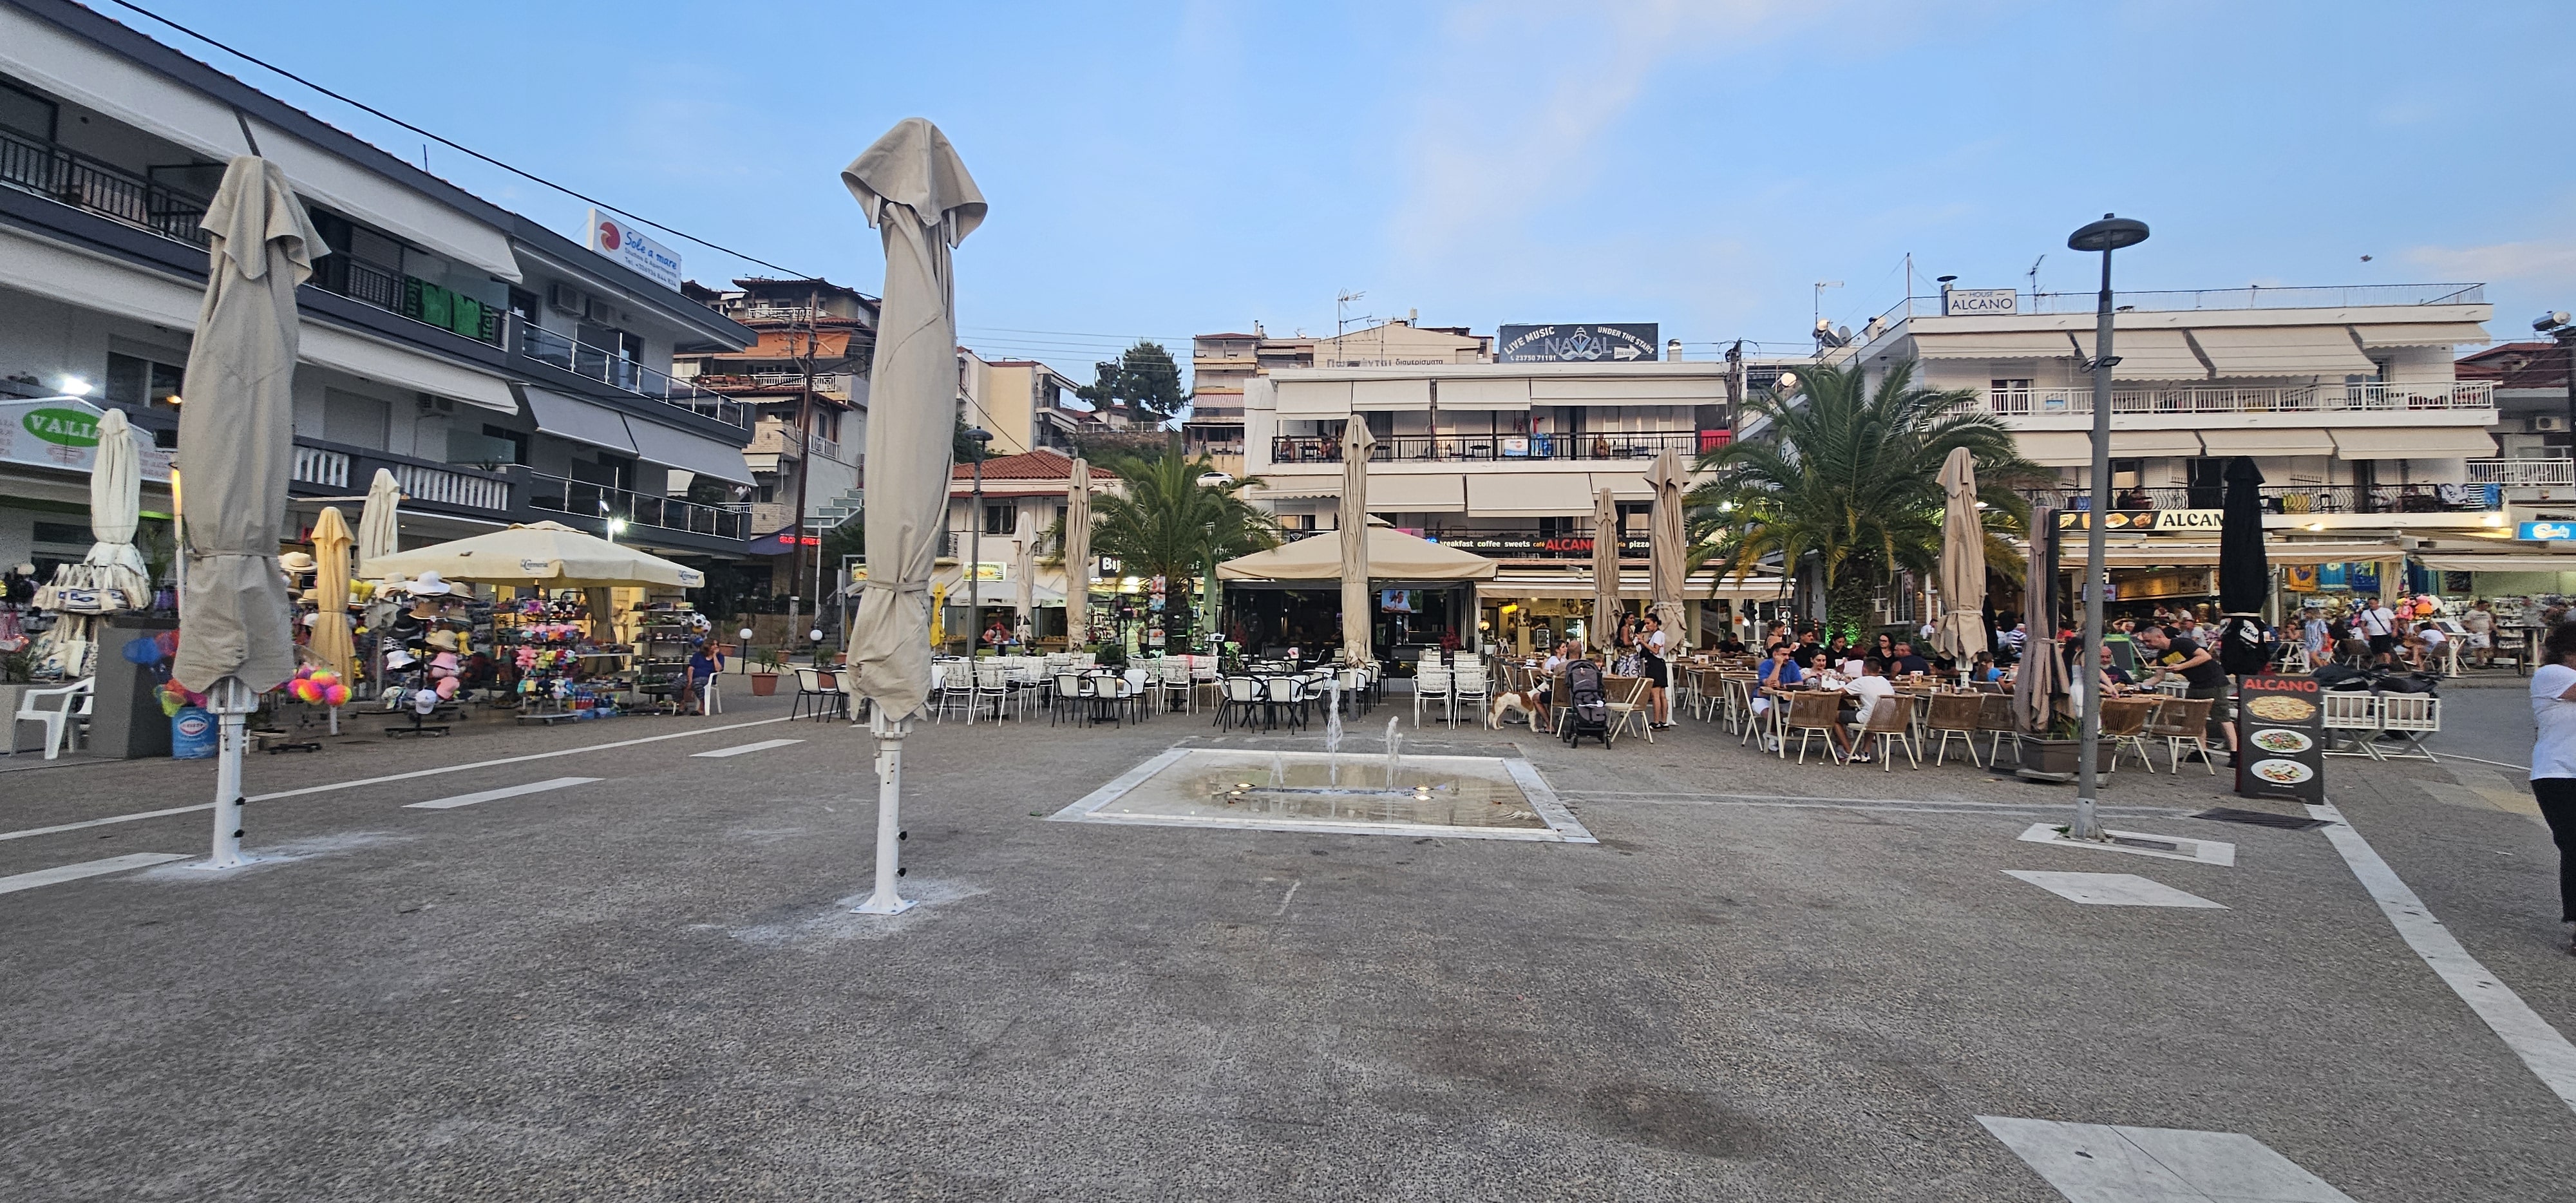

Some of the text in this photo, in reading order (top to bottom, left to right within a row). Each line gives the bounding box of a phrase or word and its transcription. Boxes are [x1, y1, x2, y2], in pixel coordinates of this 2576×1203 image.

[625, 231, 645, 253] Sole
[656, 254, 677, 269] mare
[1951, 298, 2012, 310] ALCANO
[1504, 327, 1555, 355] LIVE MUSIC
[1545, 337, 1612, 355] NAVAL
[1597, 327, 1654, 354] UNDER THE STARS
[2163, 513, 2223, 527] ALCAN
[1546, 539, 1594, 551] ALCAN
[2243, 678, 2318, 693] ALCANO
